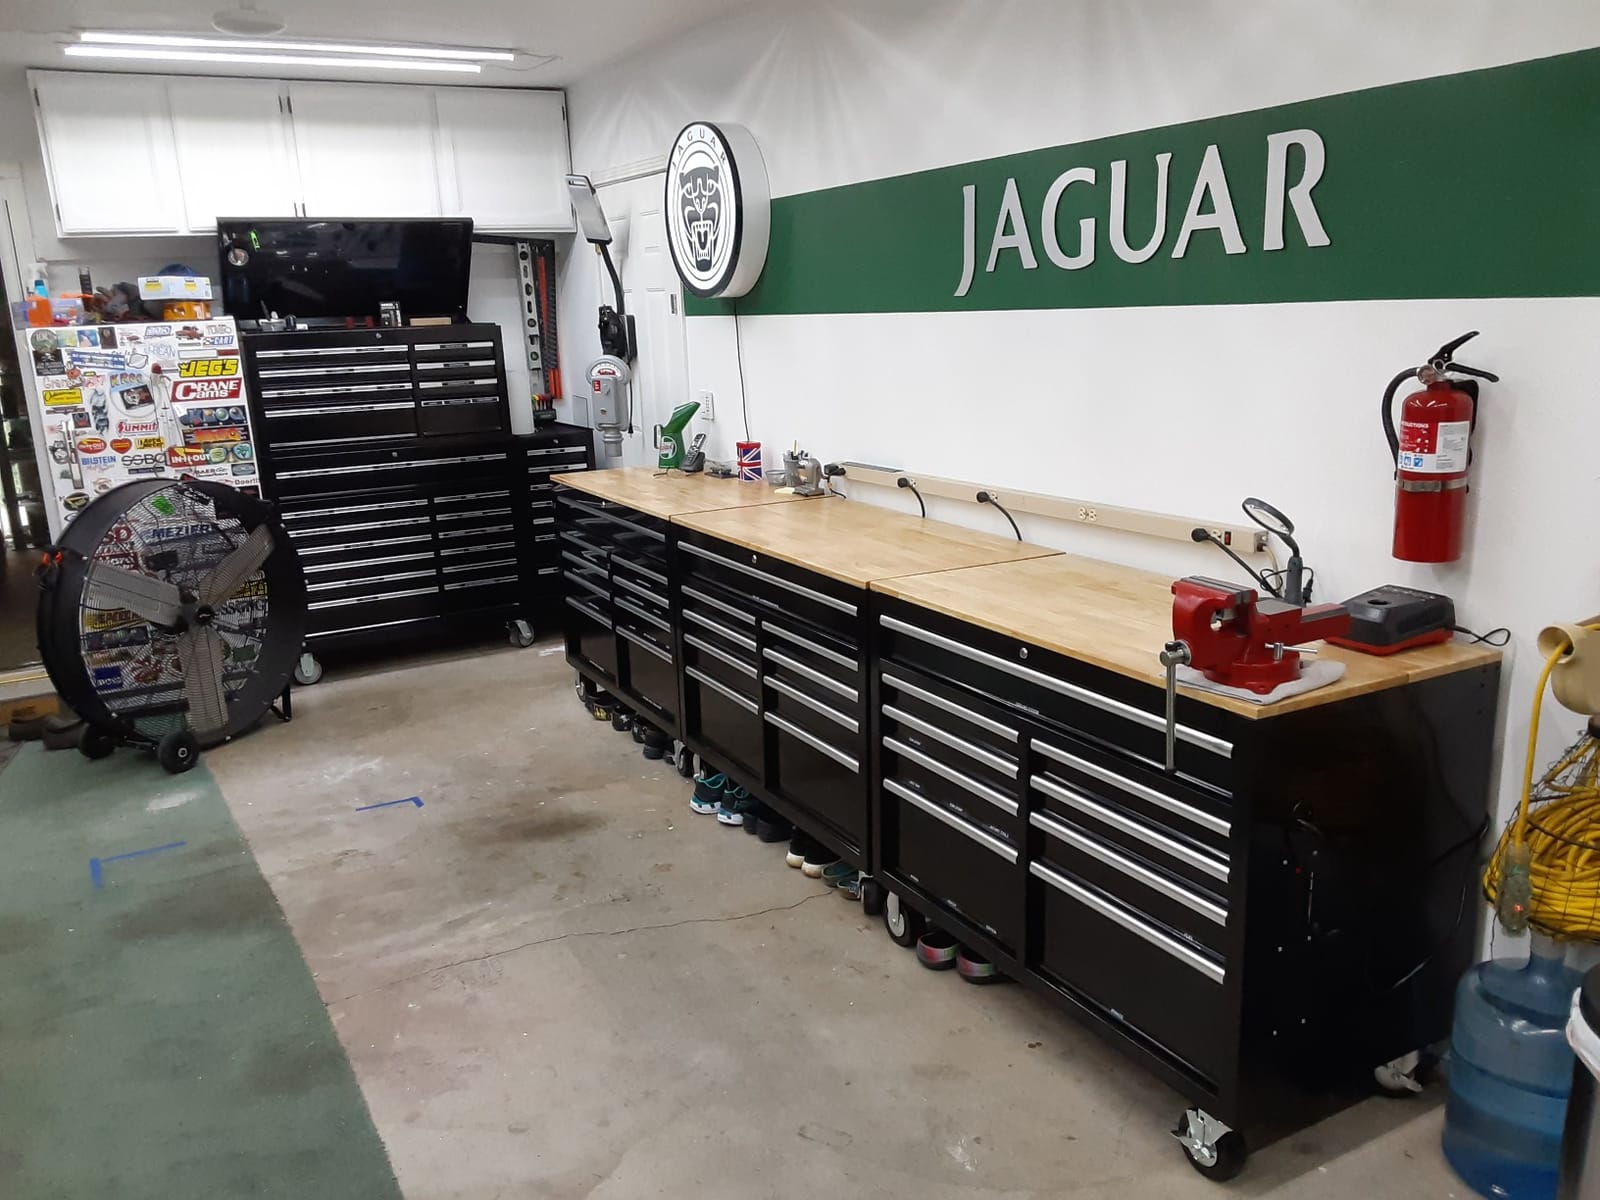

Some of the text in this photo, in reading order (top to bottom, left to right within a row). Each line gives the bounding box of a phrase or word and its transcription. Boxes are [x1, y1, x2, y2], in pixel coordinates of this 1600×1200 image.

[672, 127, 726, 171] JAGUAR
[953, 128, 1331, 297] JAGUAR
[179, 358, 239, 378] JEG'S
